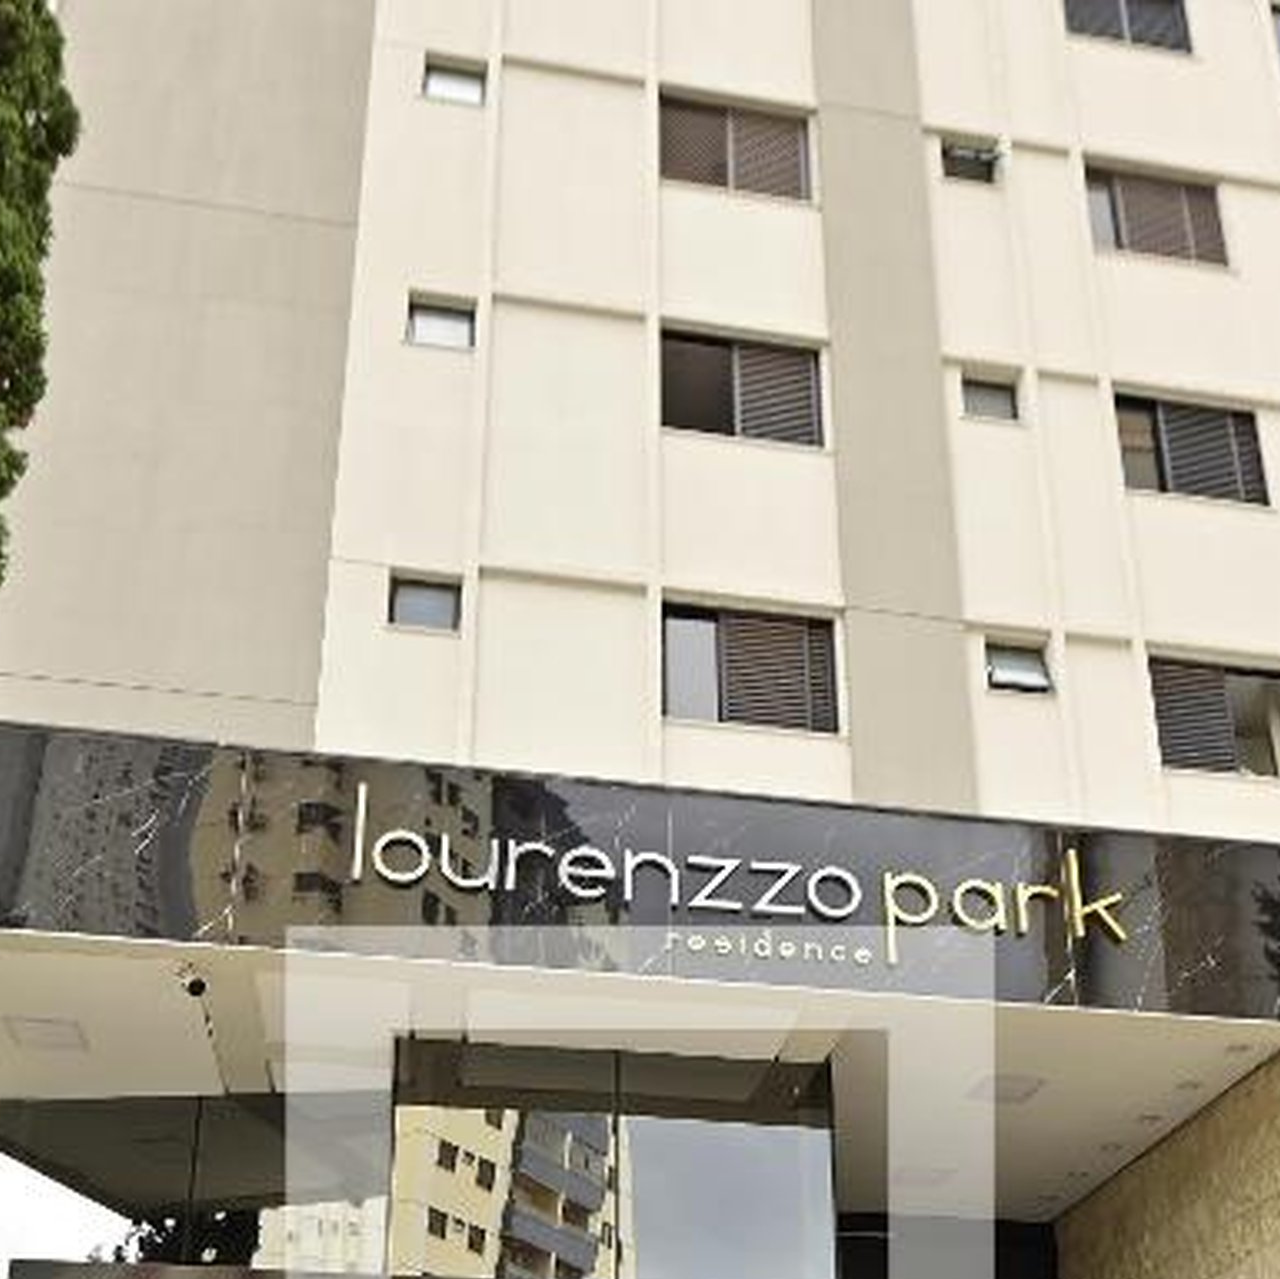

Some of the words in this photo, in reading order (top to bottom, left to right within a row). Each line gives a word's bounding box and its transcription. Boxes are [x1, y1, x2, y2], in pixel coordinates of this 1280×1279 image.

[351, 783, 863, 918] lourenzzo
[884, 849, 1128, 963] park
[666, 929, 872, 964] residence
